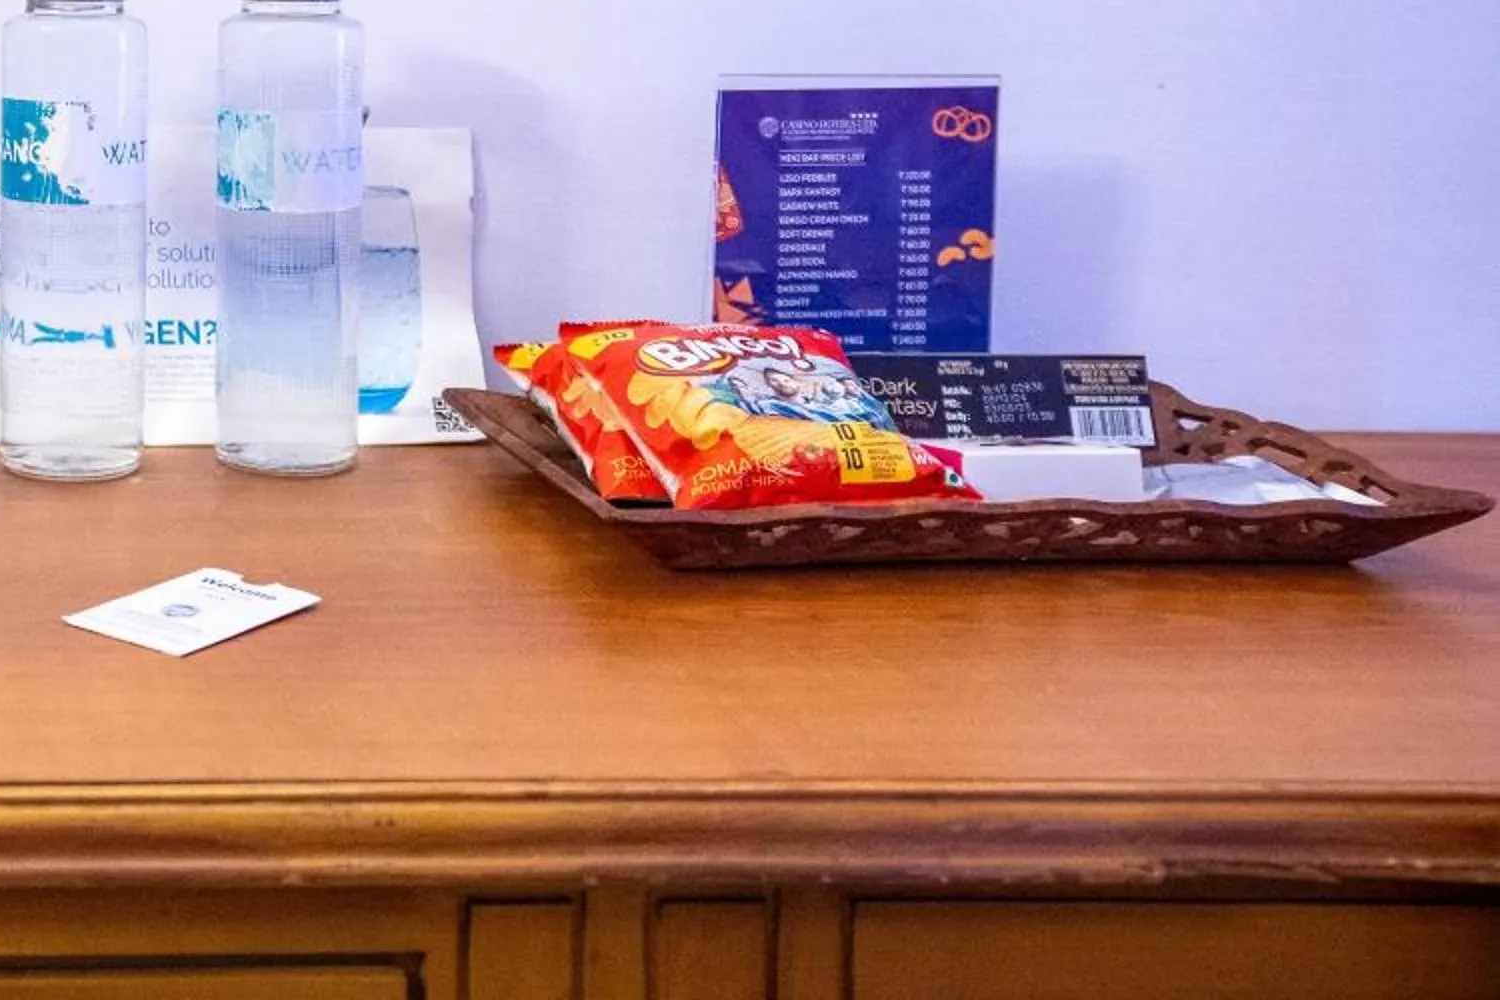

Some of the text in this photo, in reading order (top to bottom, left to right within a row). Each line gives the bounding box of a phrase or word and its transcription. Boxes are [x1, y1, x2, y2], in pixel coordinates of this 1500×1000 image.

[780, 119, 818, 129] CASINO
[102, 140, 147, 165] WAT
[149, 217, 171, 236] to
[809, 215, 839, 225] CREAM
[157, 241, 216, 263] soluti
[148, 268, 214, 289] ollutio
[643, 335, 816, 371] BINGO!
[884, 398, 938, 418] ntasy
[831, 423, 857, 441] 10
[841, 448, 864, 471] 10
